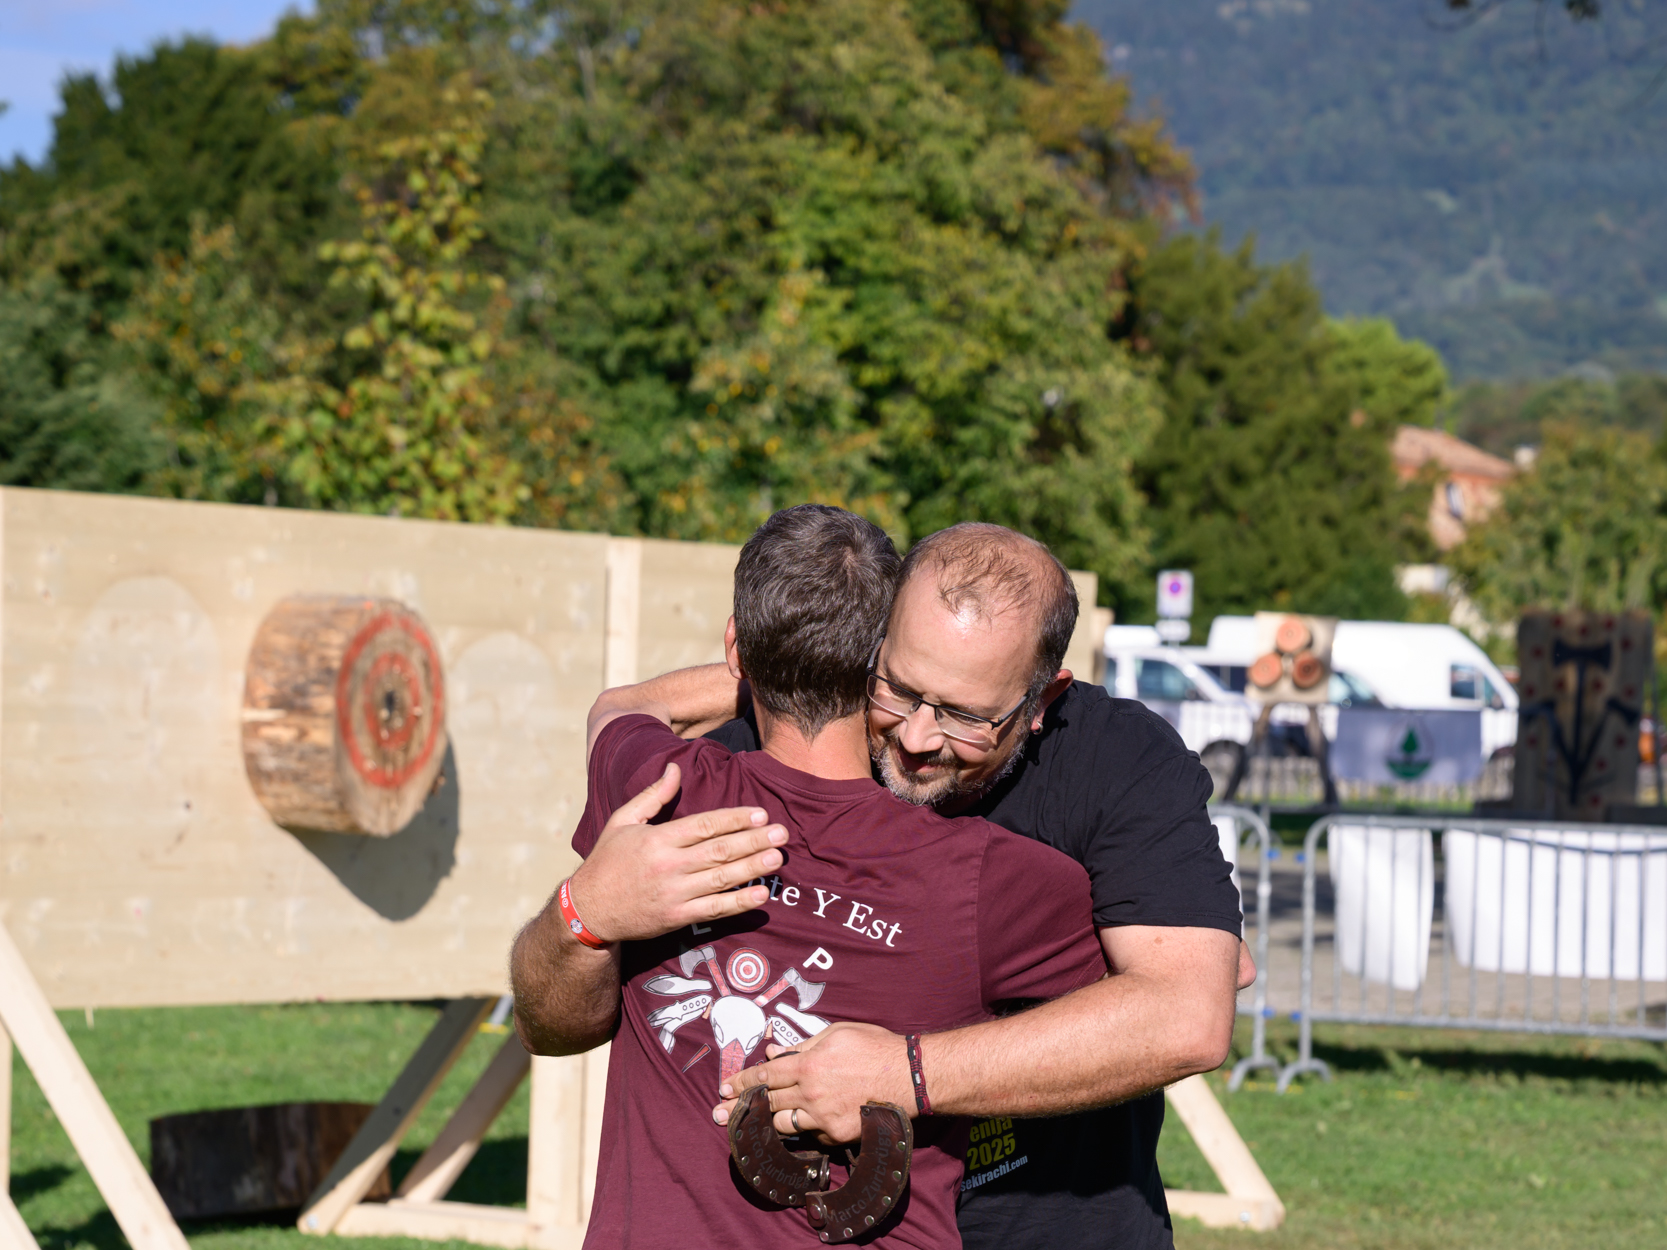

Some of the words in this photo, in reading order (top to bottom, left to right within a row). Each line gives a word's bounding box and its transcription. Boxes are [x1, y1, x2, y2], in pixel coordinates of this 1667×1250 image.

[813, 888, 841, 918] Y
[843, 900, 903, 947] Est
[802, 946, 834, 970] P
[747, 1107, 764, 1158] Marco
[966, 1133, 1016, 1171] 2025
[826, 1199, 867, 1224] Marco
[862, 1126, 892, 1200] Zurbrügg
